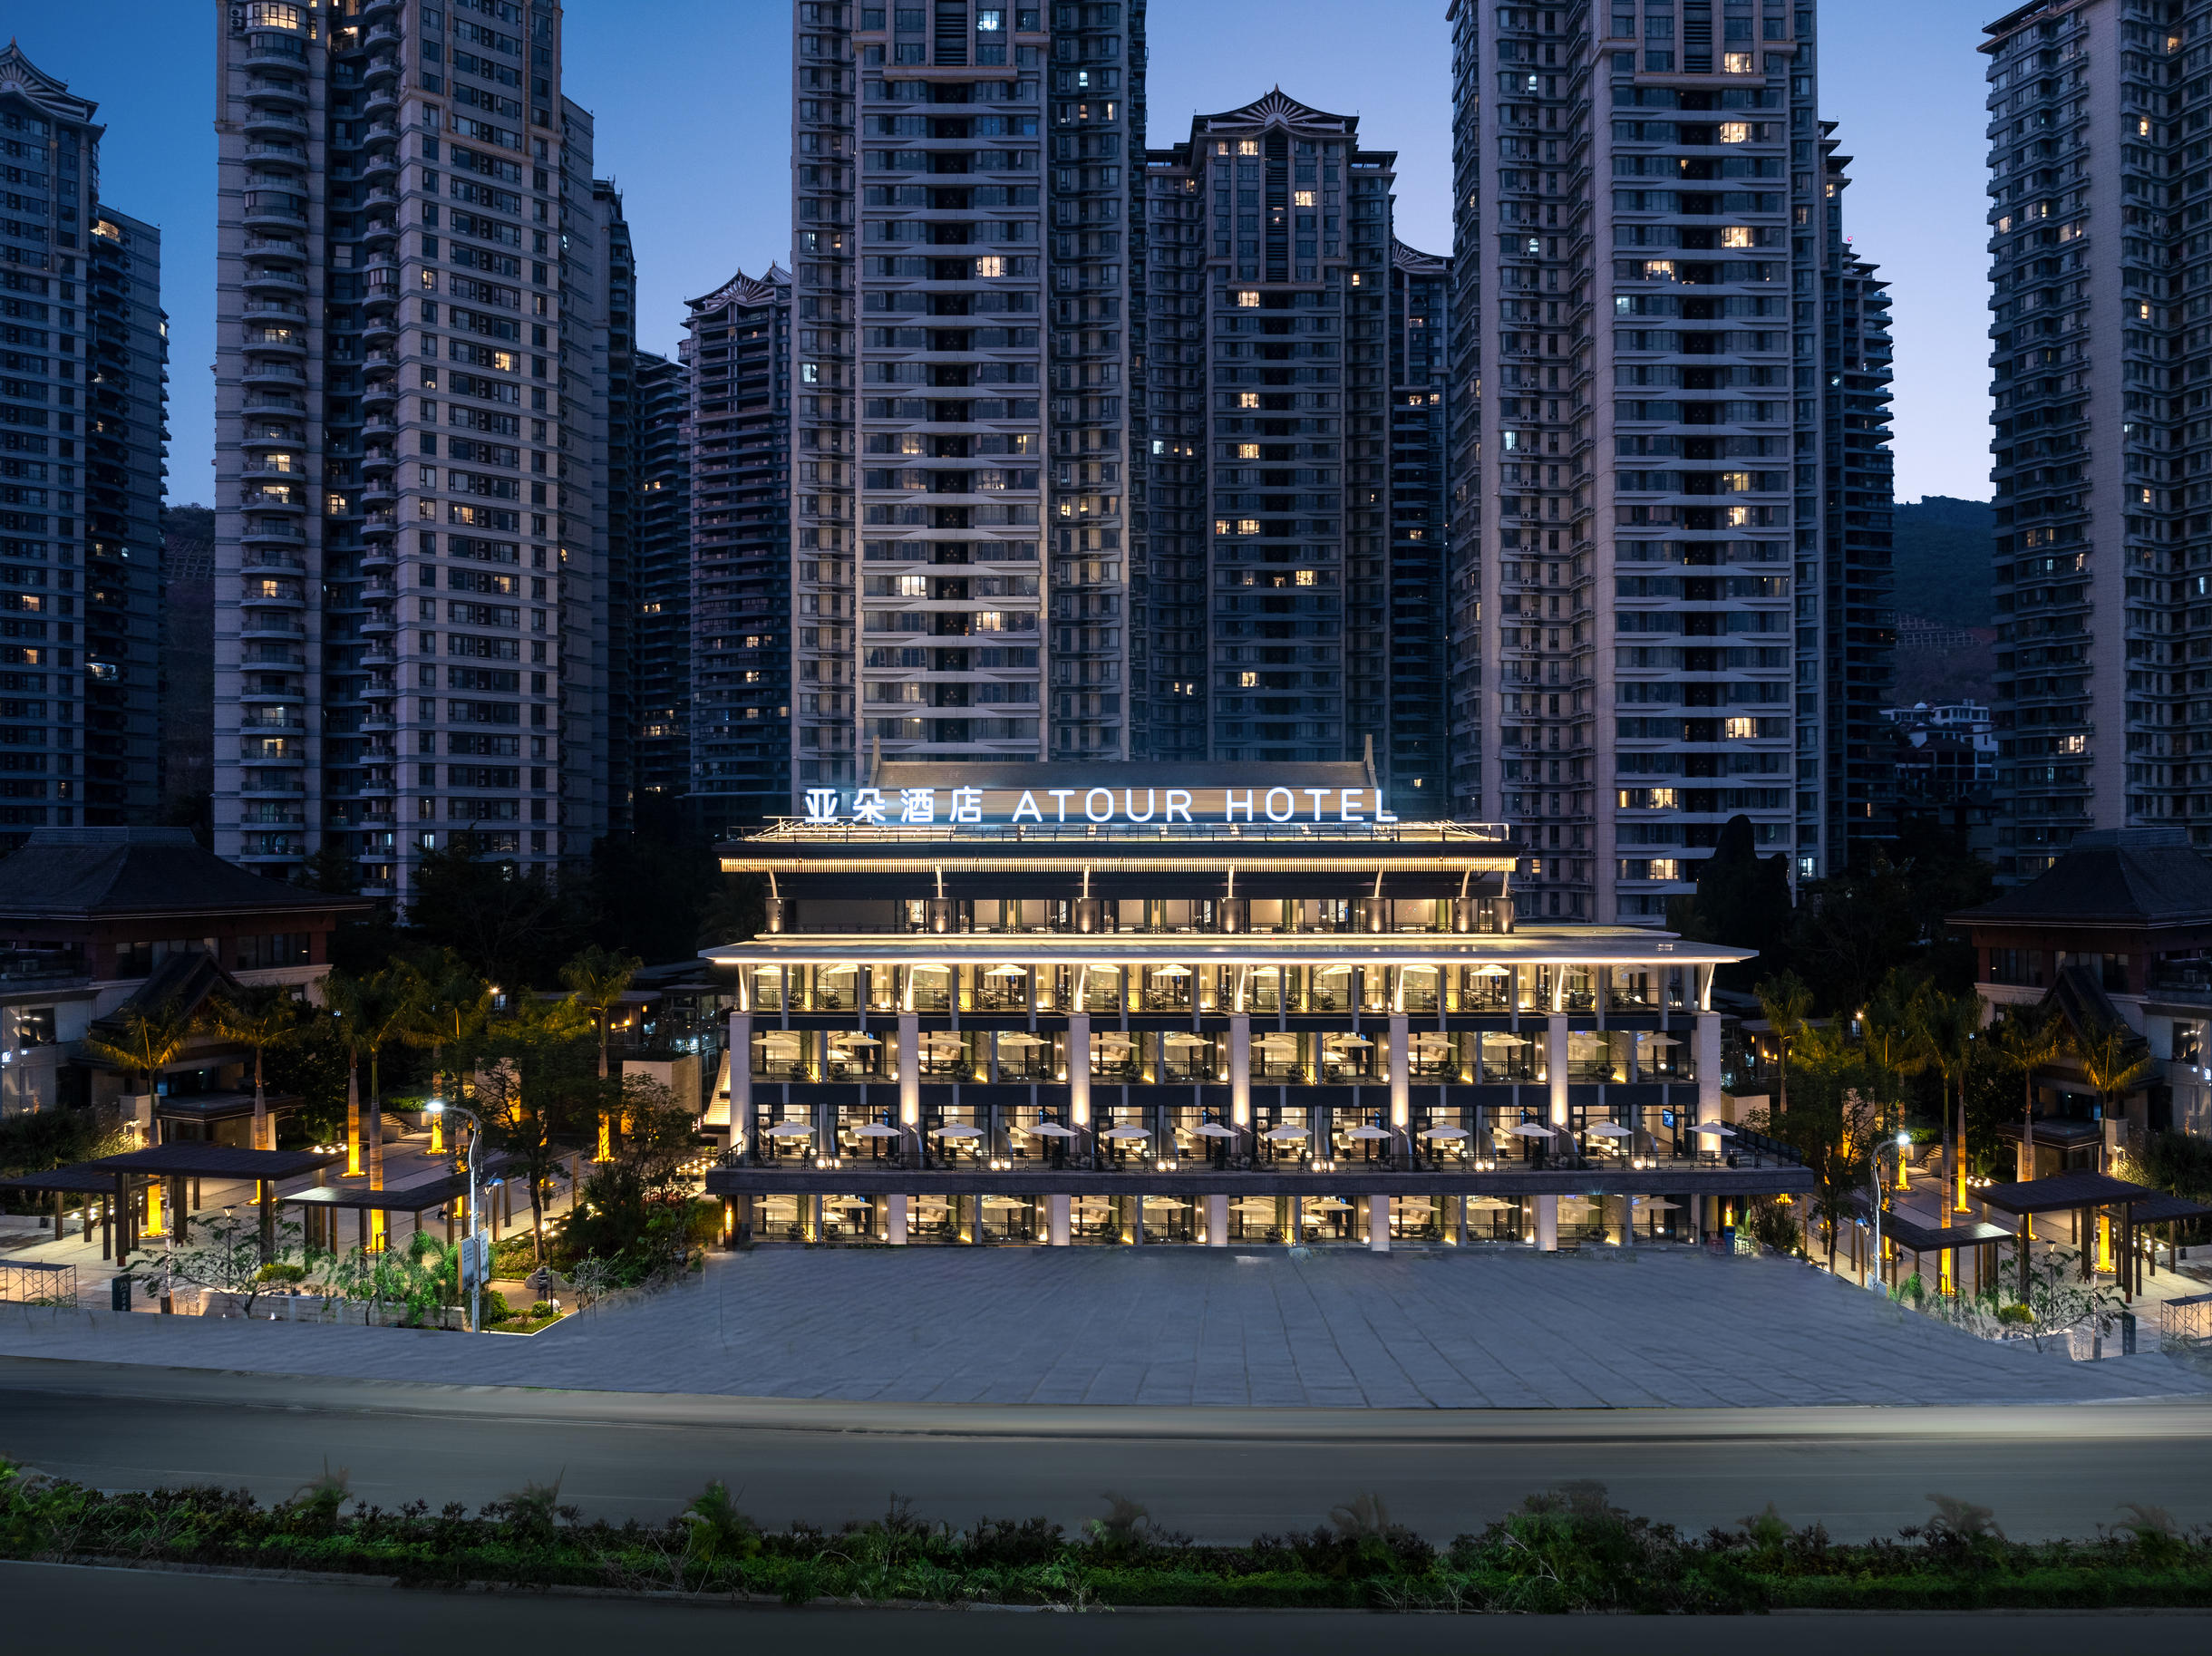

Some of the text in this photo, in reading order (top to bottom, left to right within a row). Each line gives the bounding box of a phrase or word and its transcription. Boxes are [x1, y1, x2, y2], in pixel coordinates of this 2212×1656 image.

[804, 785, 984, 823] 亚朵酒店
[1012, 787, 1399, 823] ATOUR HOTEL
